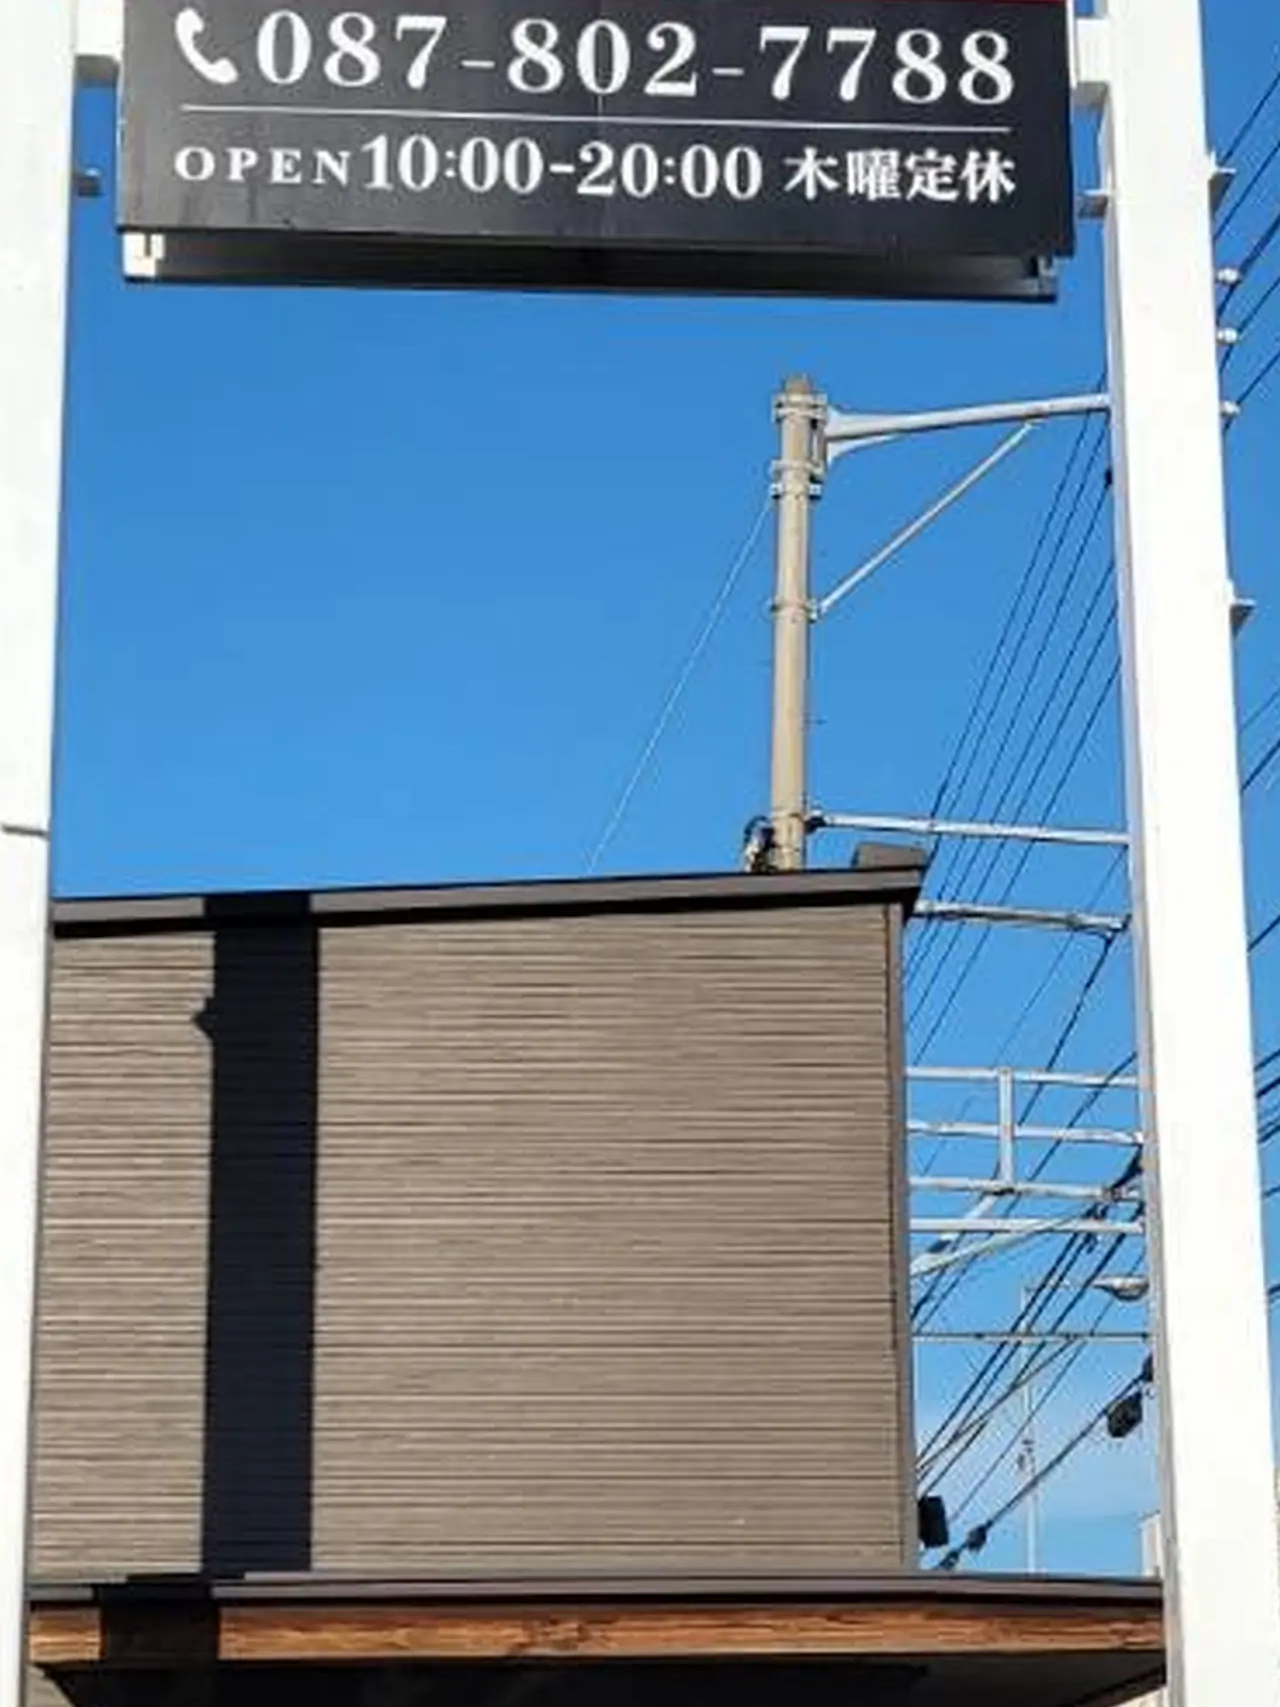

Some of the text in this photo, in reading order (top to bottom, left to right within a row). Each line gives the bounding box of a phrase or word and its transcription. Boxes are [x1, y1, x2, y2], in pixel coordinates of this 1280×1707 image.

[256, 9, 1015, 107] 087-802-7788
[784, 146, 1017, 204] 木曜定休
